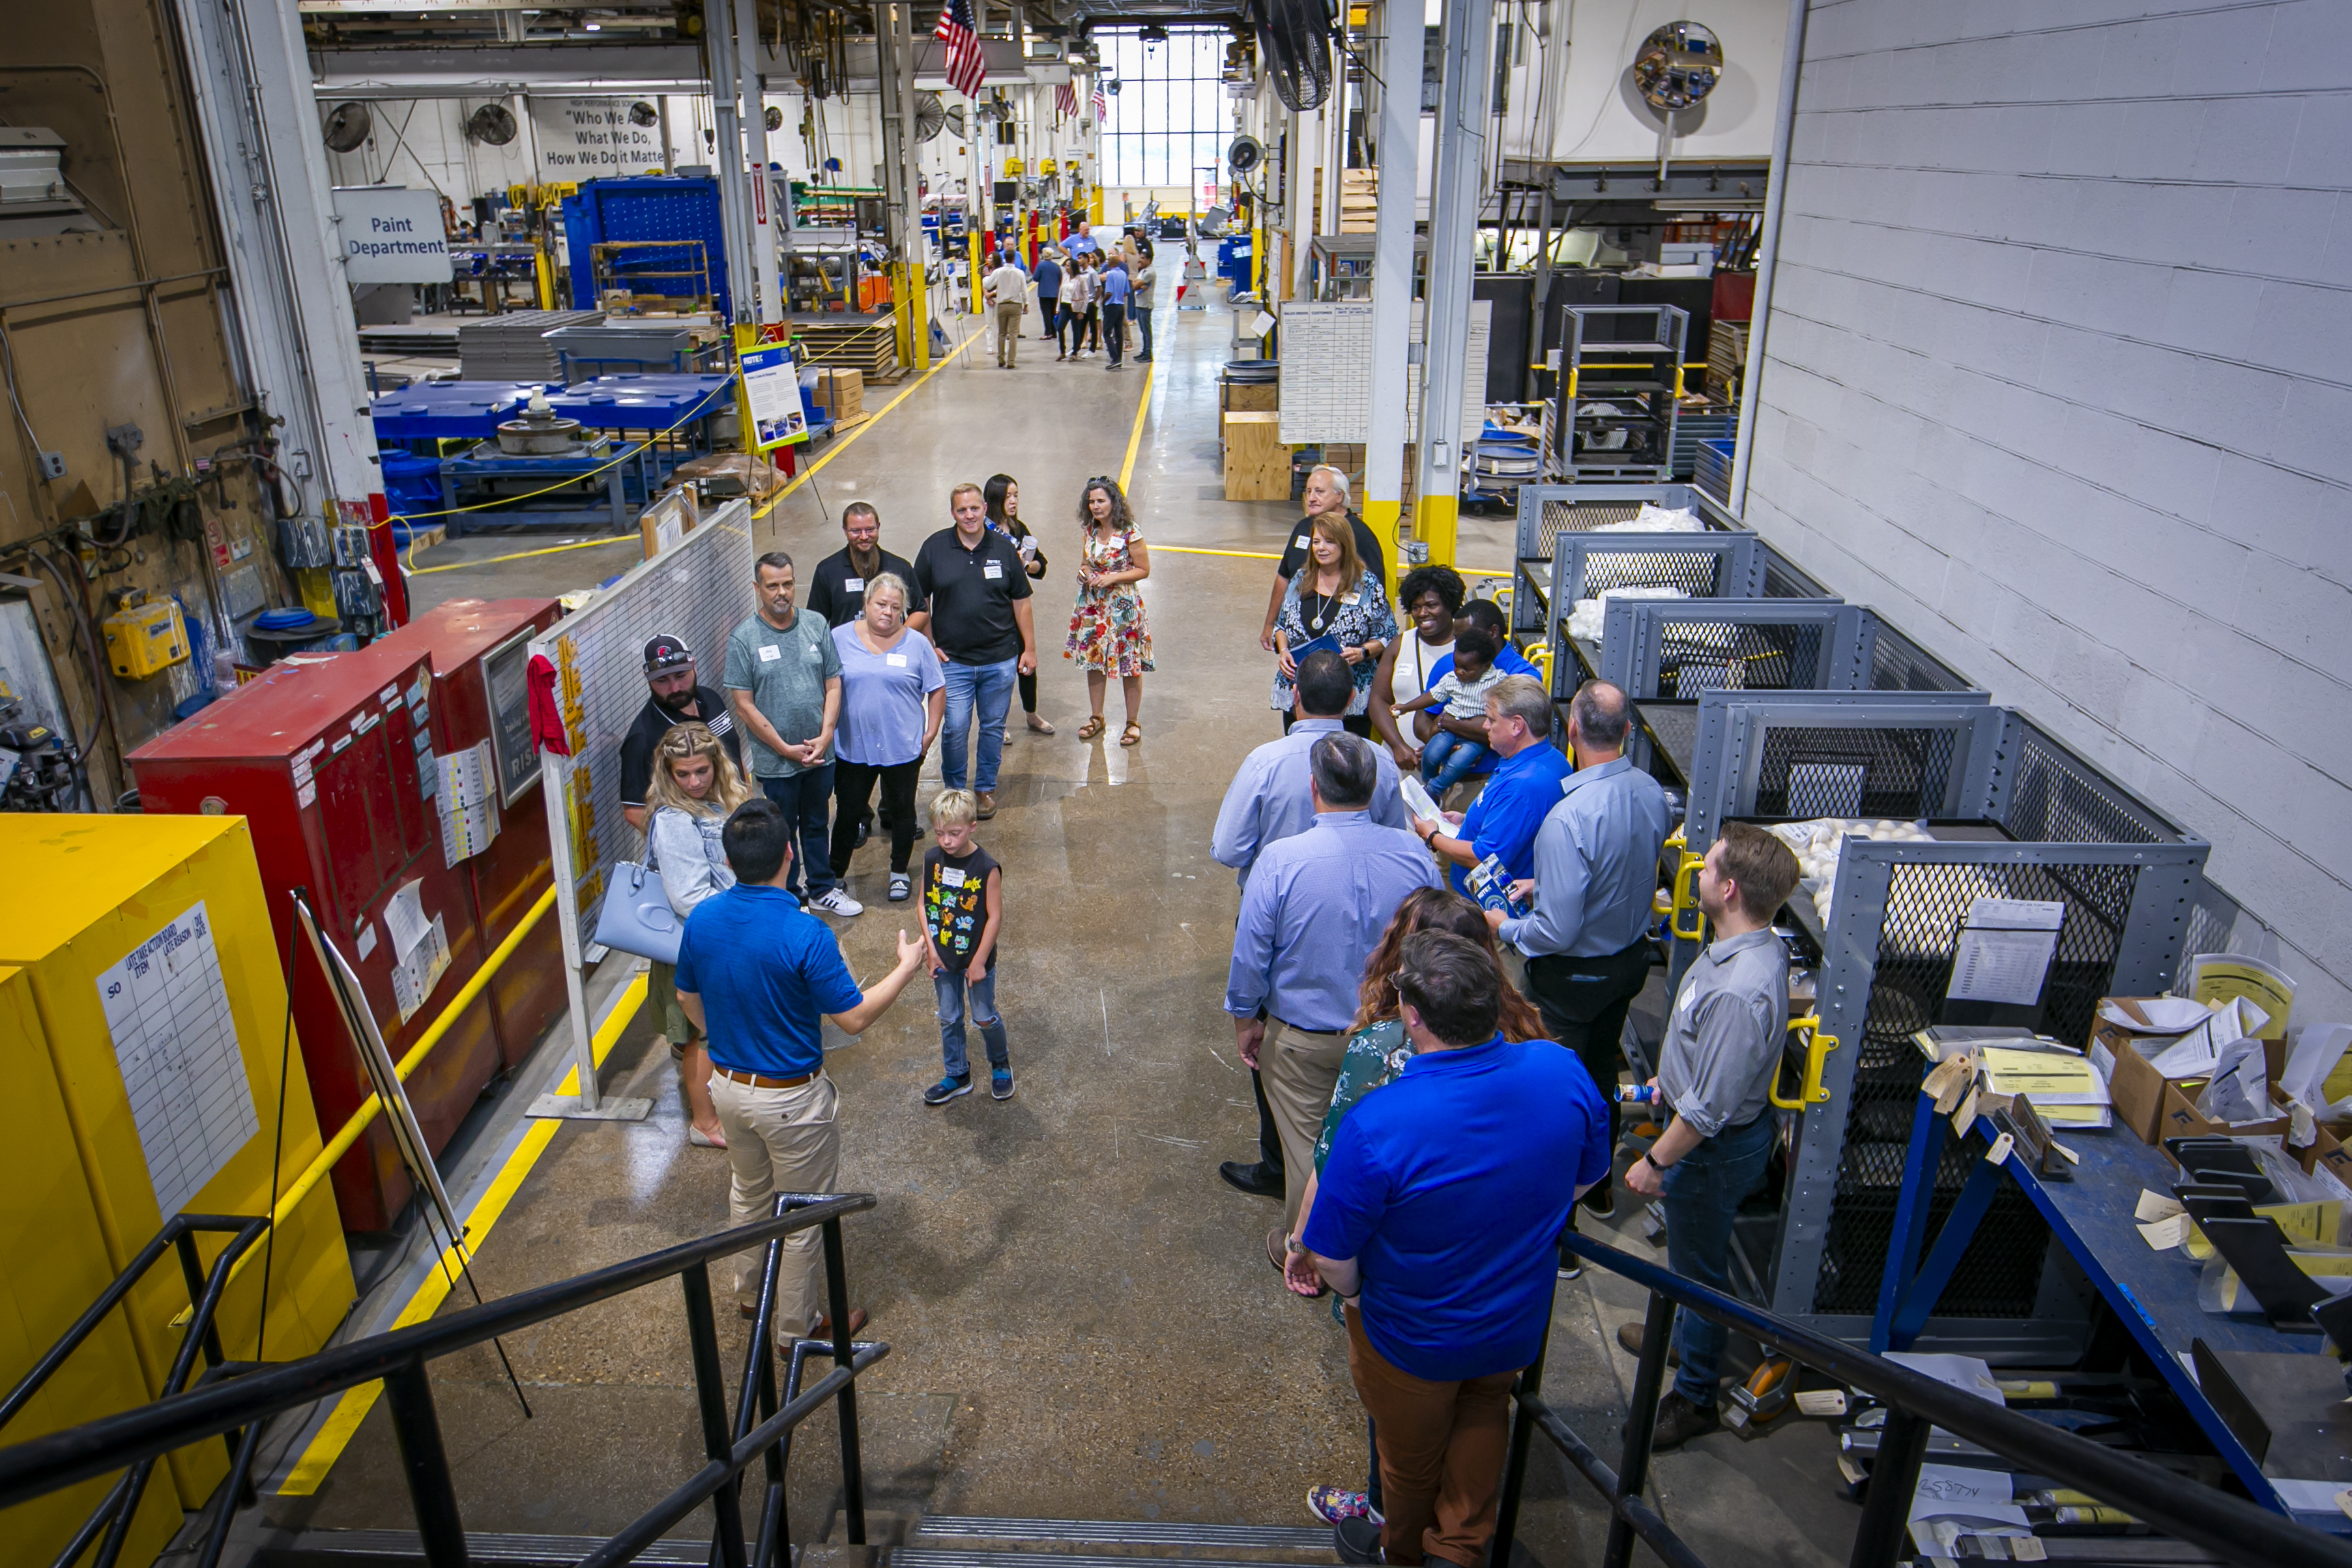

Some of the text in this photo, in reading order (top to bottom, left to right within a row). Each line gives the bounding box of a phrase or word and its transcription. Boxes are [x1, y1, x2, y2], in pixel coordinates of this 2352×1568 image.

[605, 111, 624, 124] We
[575, 130, 651, 145] What We Do,
[547, 152, 575, 165] How
[578, 151, 598, 164] We
[601, 151, 617, 164] Do
[620, 150, 628, 163] it
[371, 217, 413, 233] Paint
[349, 240, 445, 258] Department
[194, 912, 204, 927] DUE
[196, 923, 207, 939] DATE
[125, 923, 178, 971] LATE TAKE ACTION BOARD
[163, 927, 192, 956] LATE REASON
[134, 959, 151, 979] ITEM
[108, 981, 122, 999] SO
